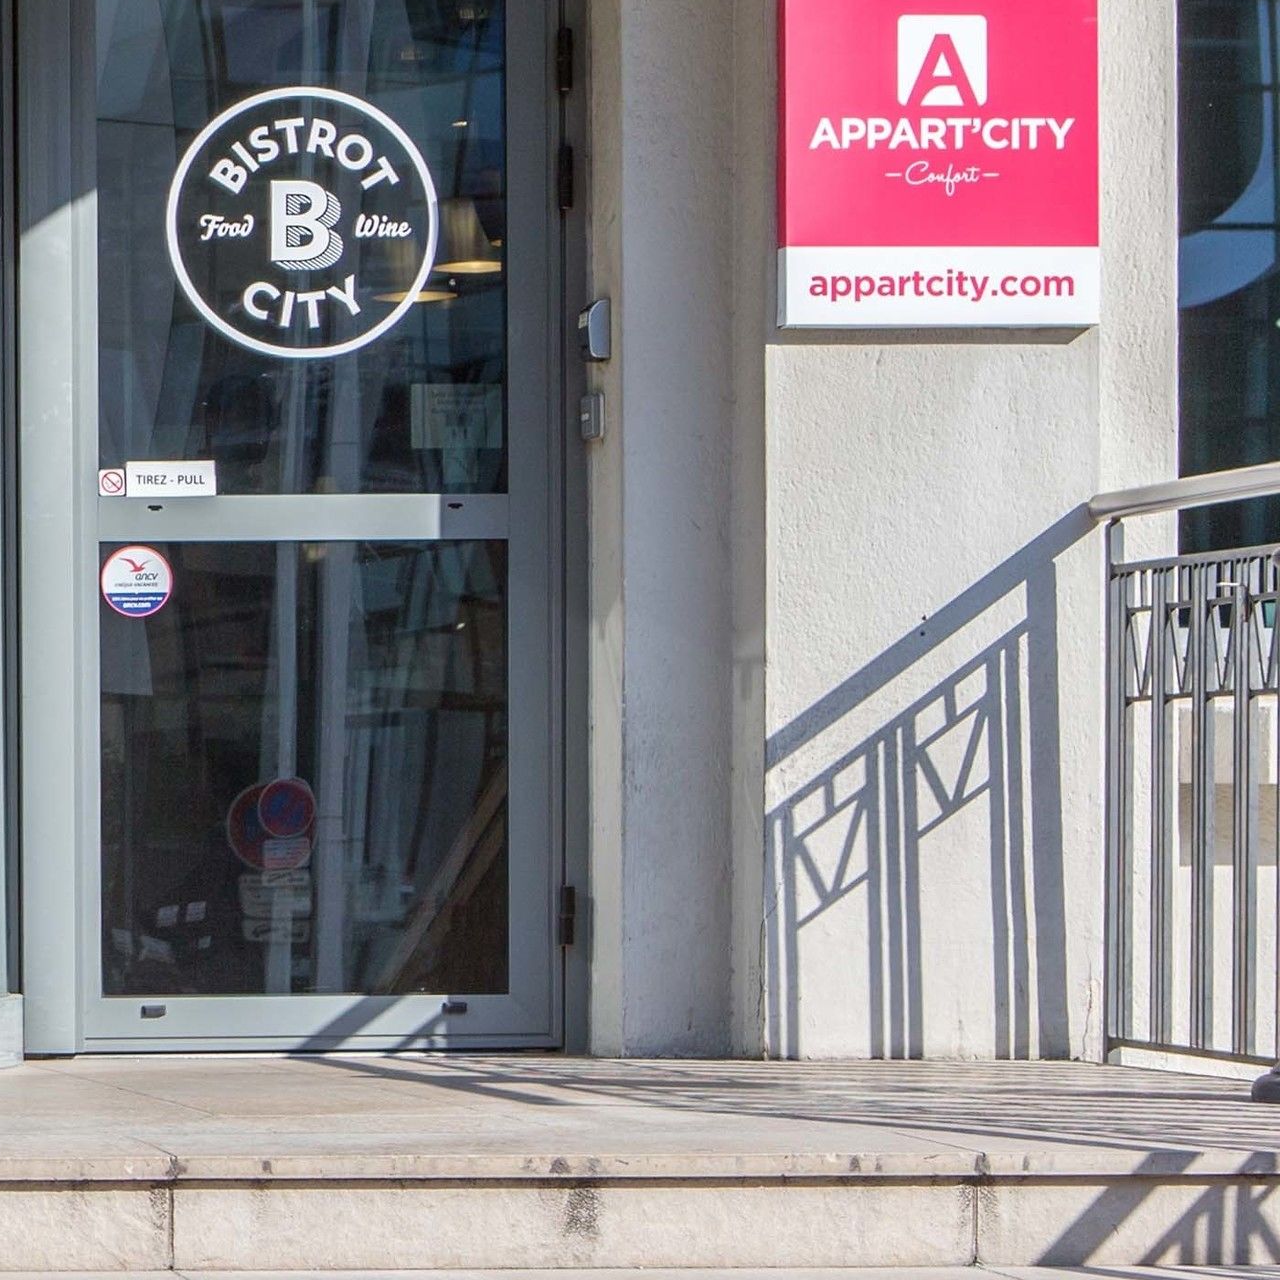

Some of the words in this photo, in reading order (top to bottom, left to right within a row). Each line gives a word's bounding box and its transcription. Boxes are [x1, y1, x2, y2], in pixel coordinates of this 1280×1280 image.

[809, 117, 1075, 150] APPART'CITY
[208, 117, 400, 195] BISTROT
[905, 160, 981, 197] Confort
[200, 214, 254, 241] Food
[355, 214, 412, 238] Wine
[243, 274, 361, 328] CITY
[809, 269, 1075, 302] appartcity.com
[136, 475, 167, 485] TIREZ
[177, 474, 205, 485] PULL
